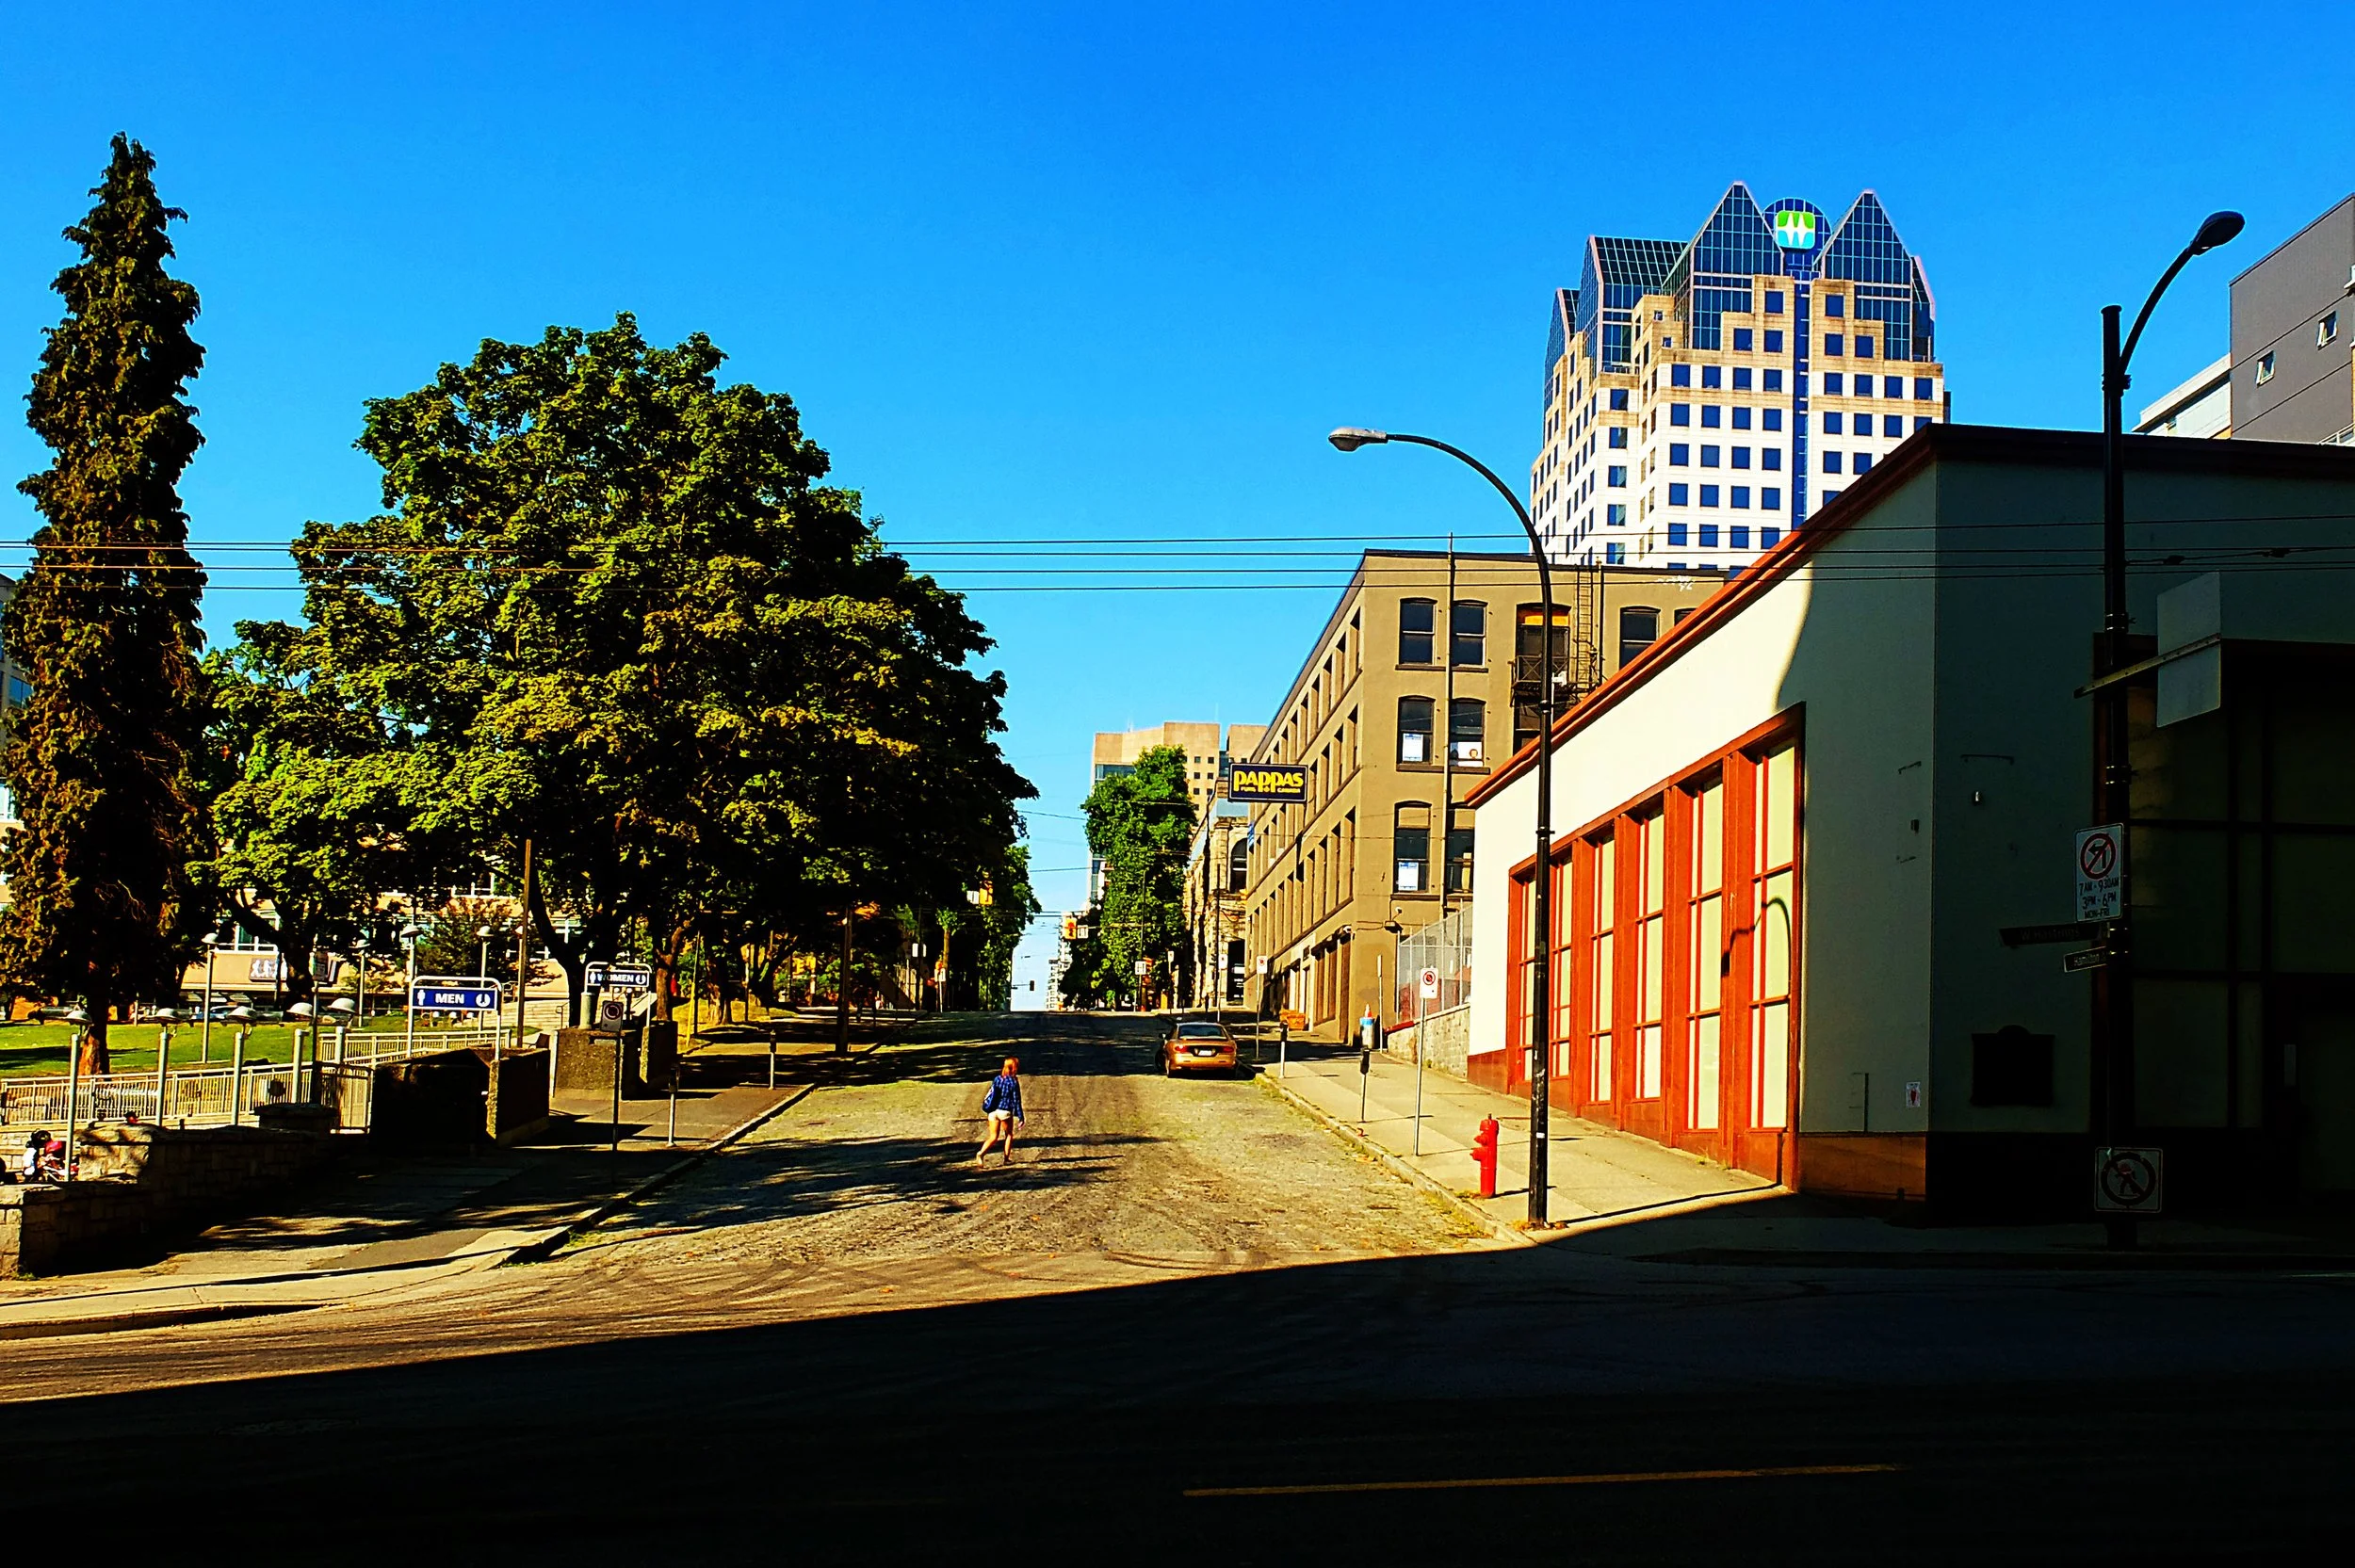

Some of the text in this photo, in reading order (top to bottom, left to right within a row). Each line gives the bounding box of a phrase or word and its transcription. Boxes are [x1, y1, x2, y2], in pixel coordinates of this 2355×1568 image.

[1233, 770, 1304, 793] PAPPAS
[597, 973, 634, 982] WOMEN
[435, 994, 464, 1004] MEN
